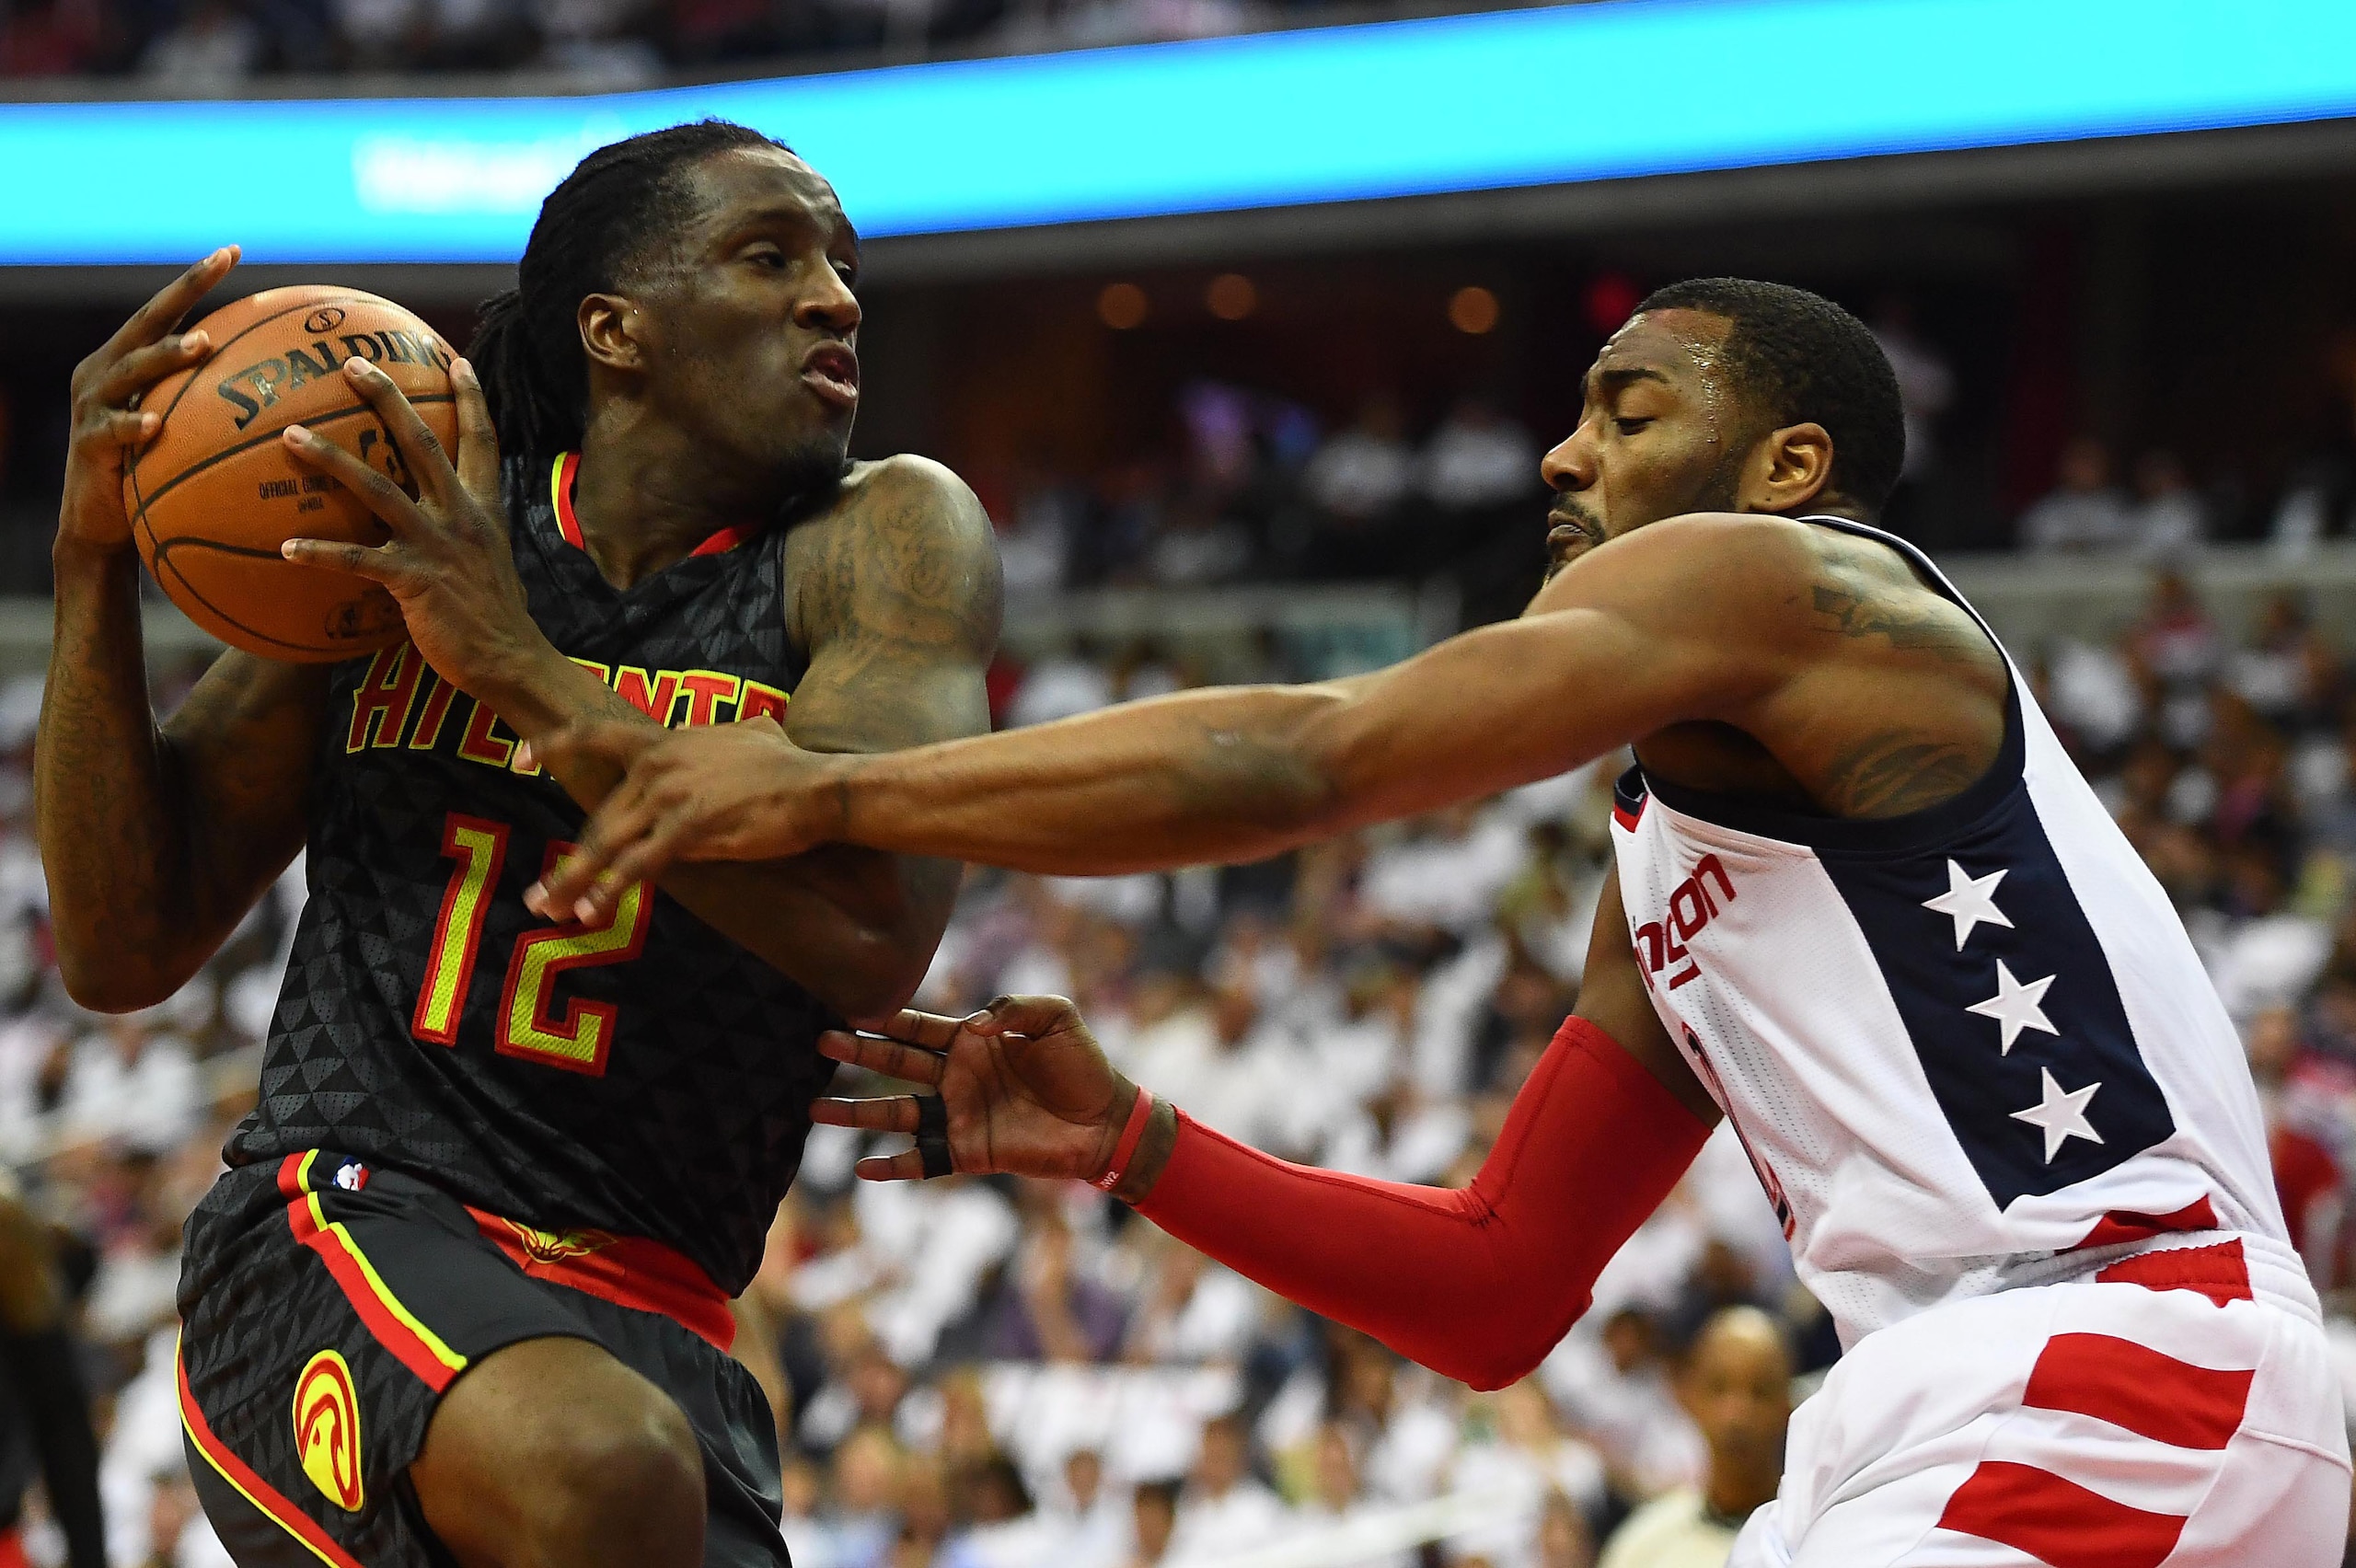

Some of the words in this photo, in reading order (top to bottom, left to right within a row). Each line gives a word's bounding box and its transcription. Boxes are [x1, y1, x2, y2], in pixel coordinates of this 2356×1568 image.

[217, 330, 451, 431] SPALDING
[260, 479, 299, 500] OFFICIAL
[412, 813, 657, 1078] 12
